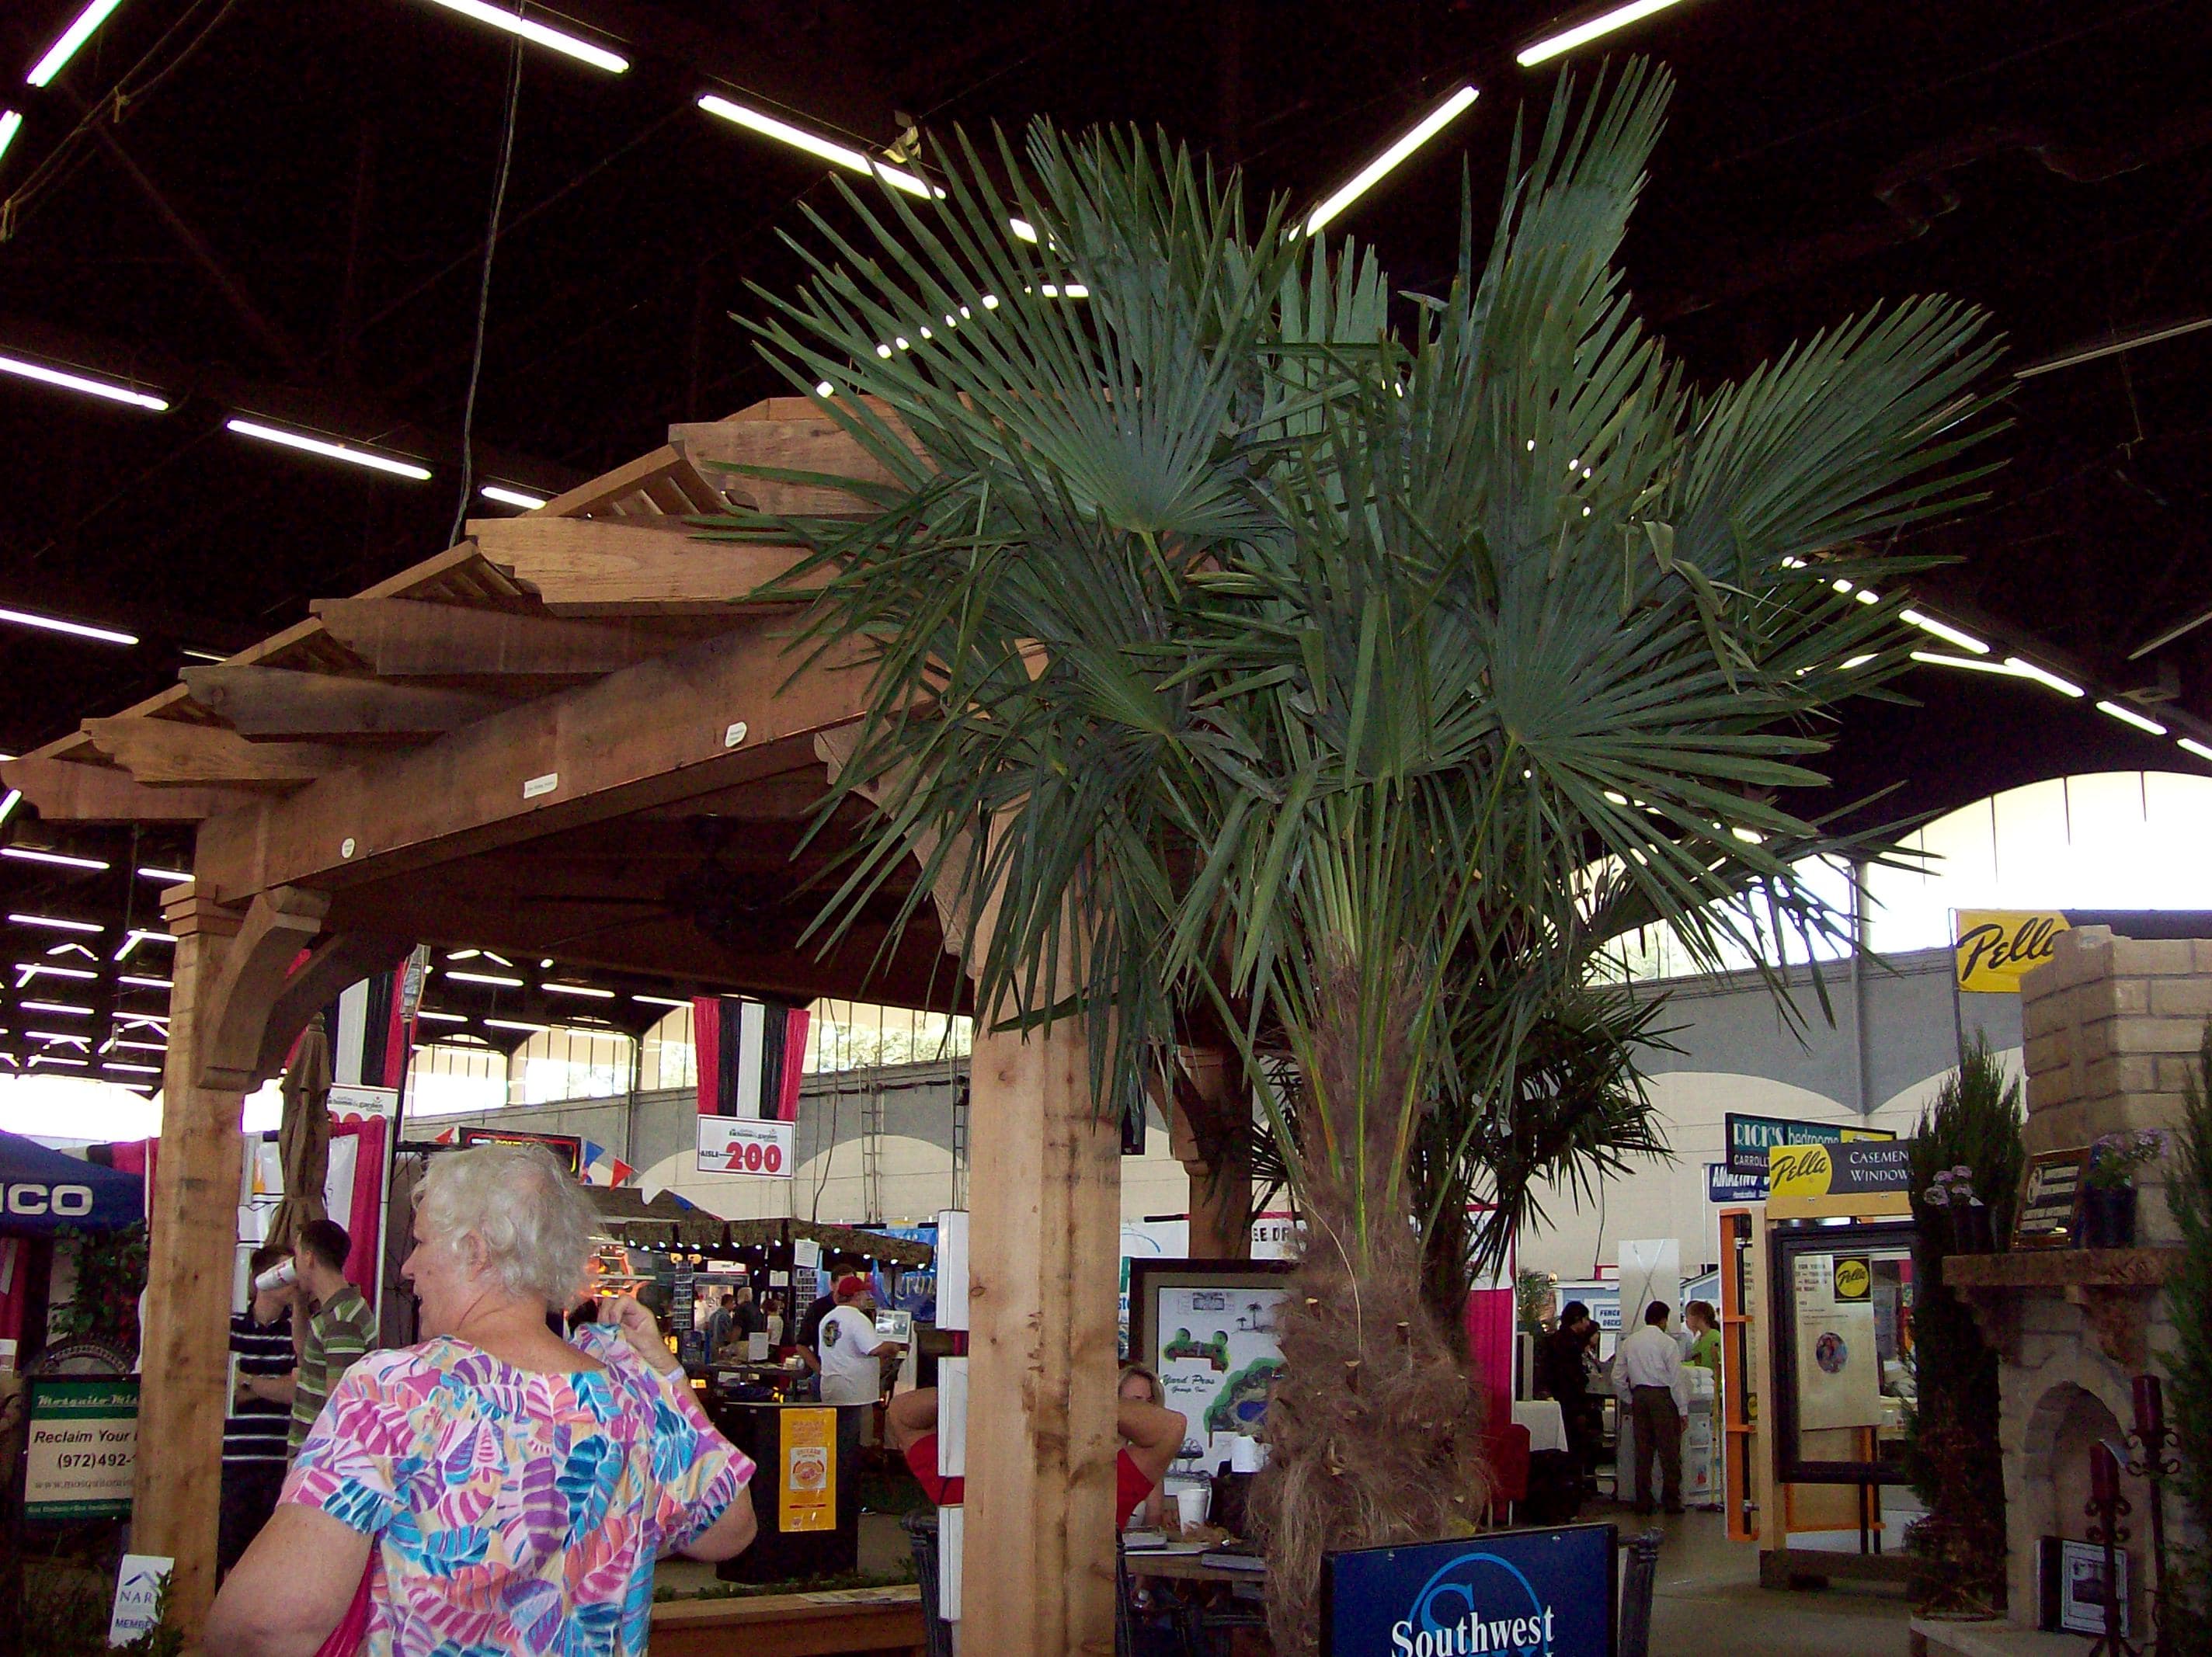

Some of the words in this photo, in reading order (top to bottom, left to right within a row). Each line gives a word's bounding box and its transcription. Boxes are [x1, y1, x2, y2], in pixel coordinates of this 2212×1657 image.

[725, 1141, 781, 1172] 200
[1850, 1152, 1909, 1165] CASEMEN
[1771, 1151, 1828, 1190] Pella
[1850, 1169, 1908, 1182] WINDOW
[1838, 1268, 1866, 1289] Pella
[1162, 1374, 1188, 1386] Yard
[1191, 1374, 1215, 1384] Pros
[34, 1430, 92, 1443] Reclaim
[99, 1429, 130, 1442] Your
[58, 1453, 137, 1470] (972)492-
[120, 1591, 153, 1603] NAR
[115, 1618, 151, 1629] MEMBE
[1392, 1605, 1555, 1657] Southwest
